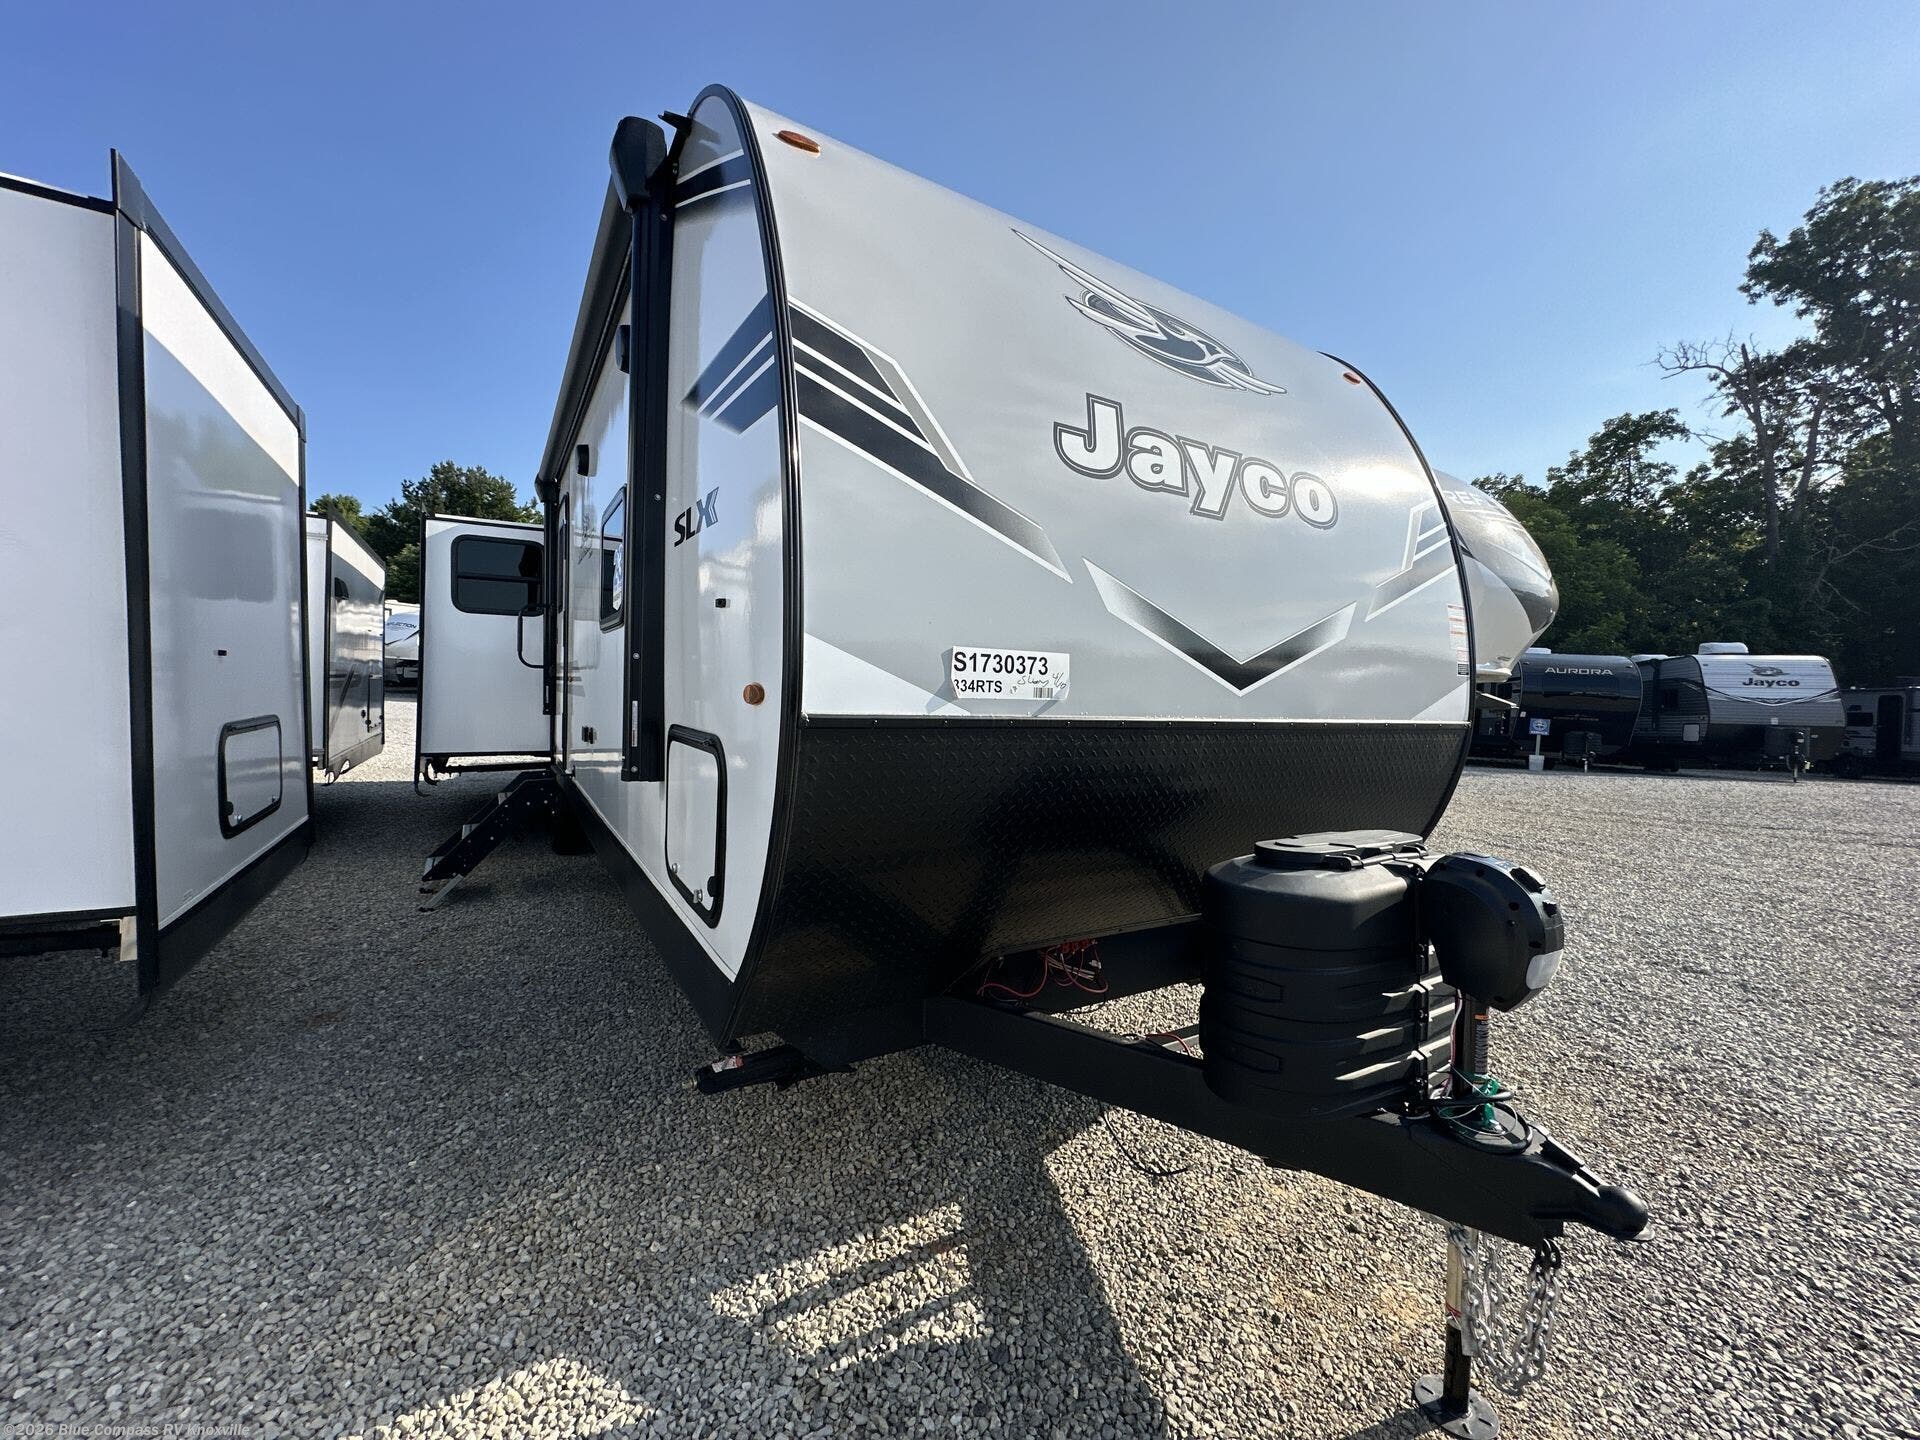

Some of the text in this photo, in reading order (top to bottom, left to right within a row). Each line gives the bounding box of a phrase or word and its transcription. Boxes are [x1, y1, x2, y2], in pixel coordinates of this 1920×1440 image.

[1053, 392, 1338, 530] Jayco
[673, 487, 720, 547] SLX
[953, 651, 1049, 675] S1730373
[1544, 667, 1614, 676] AURORA
[1742, 677, 1800, 688] Jayco
